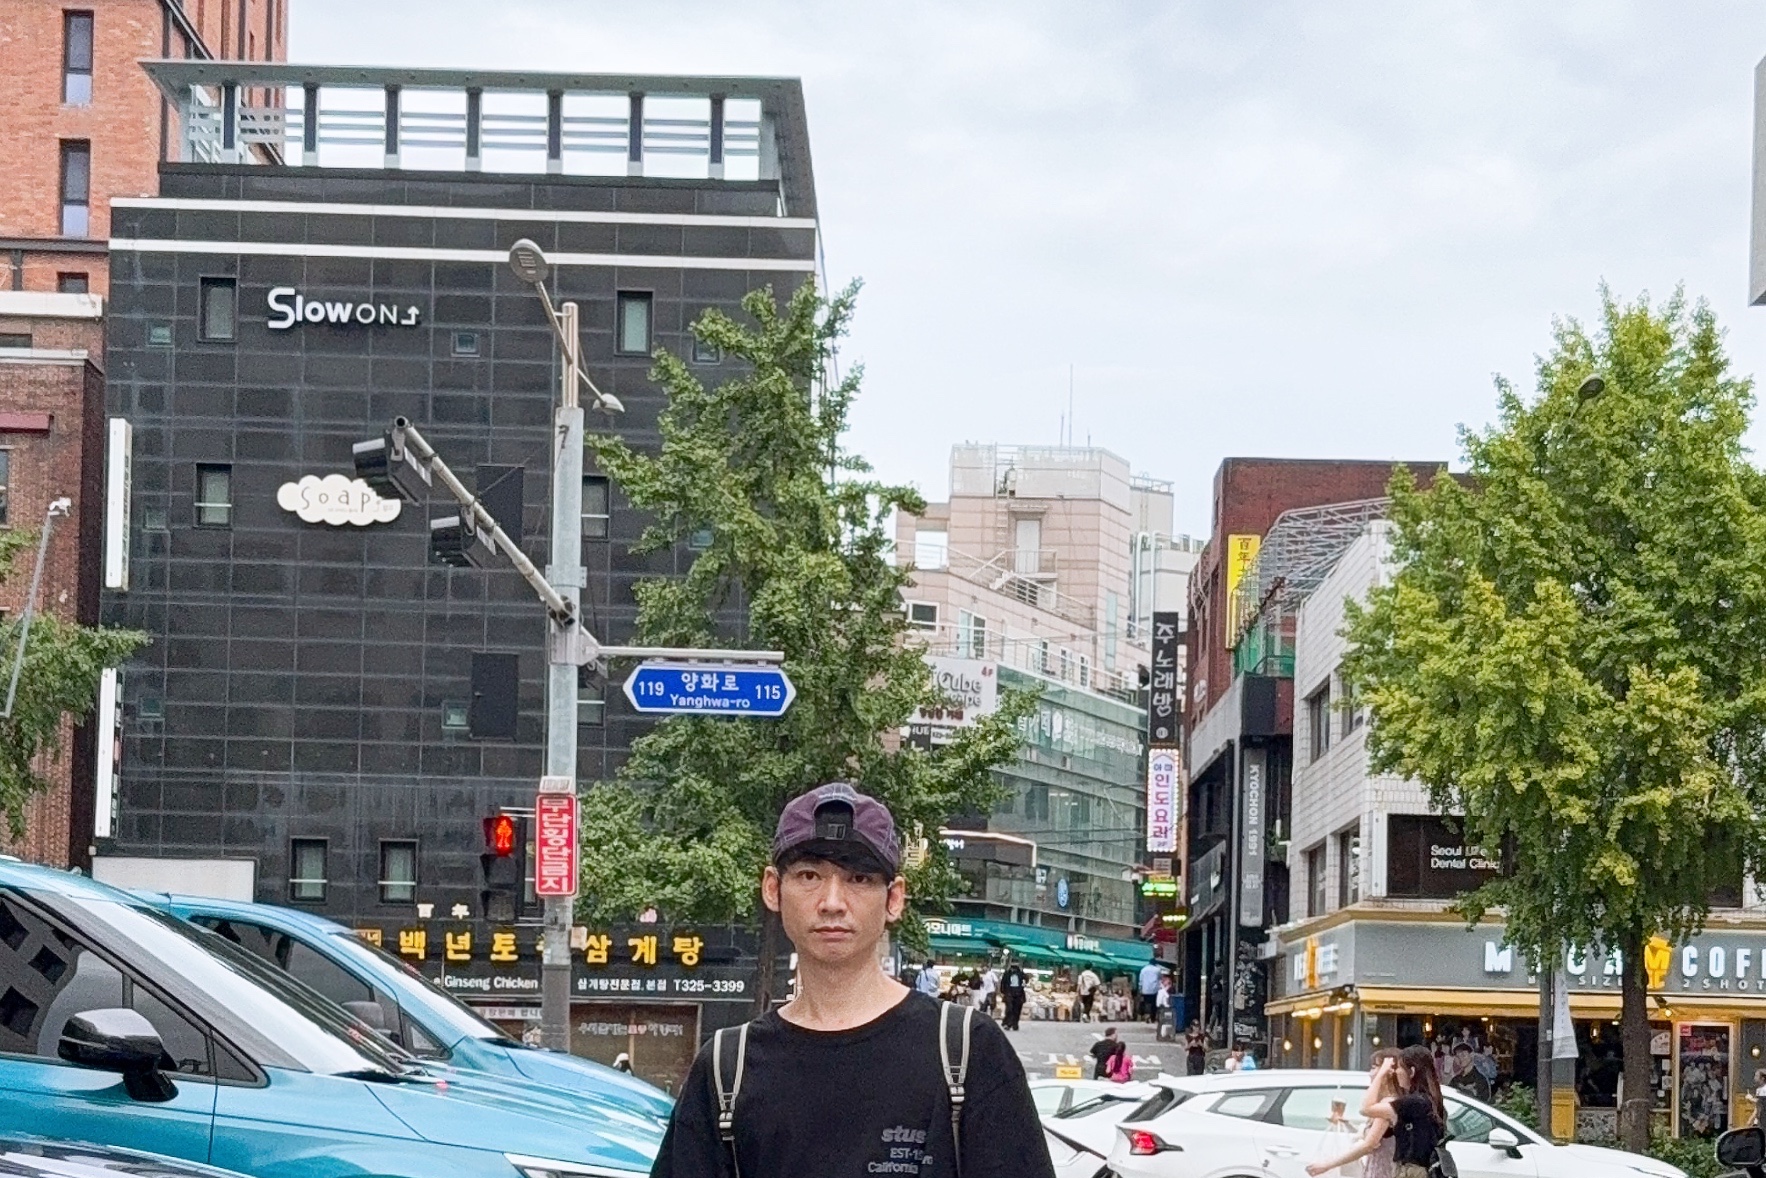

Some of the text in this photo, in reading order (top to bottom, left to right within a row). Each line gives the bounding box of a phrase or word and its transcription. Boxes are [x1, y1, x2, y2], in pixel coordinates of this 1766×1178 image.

[638, 672, 781, 700] 119 양화로 115
[670, 693, 750, 708] Yanghwa-ro
[1248, 764, 1260, 825] KYOCHON
[541, 798, 572, 892] 무단횡단금지
[1430, 845, 1462, 856] Seoul
[1430, 858, 1466, 869] Dental
[444, 976, 491, 990] Ginseng
[494, 976, 539, 989] Chicken
[674, 979, 745, 992] T325-3399
